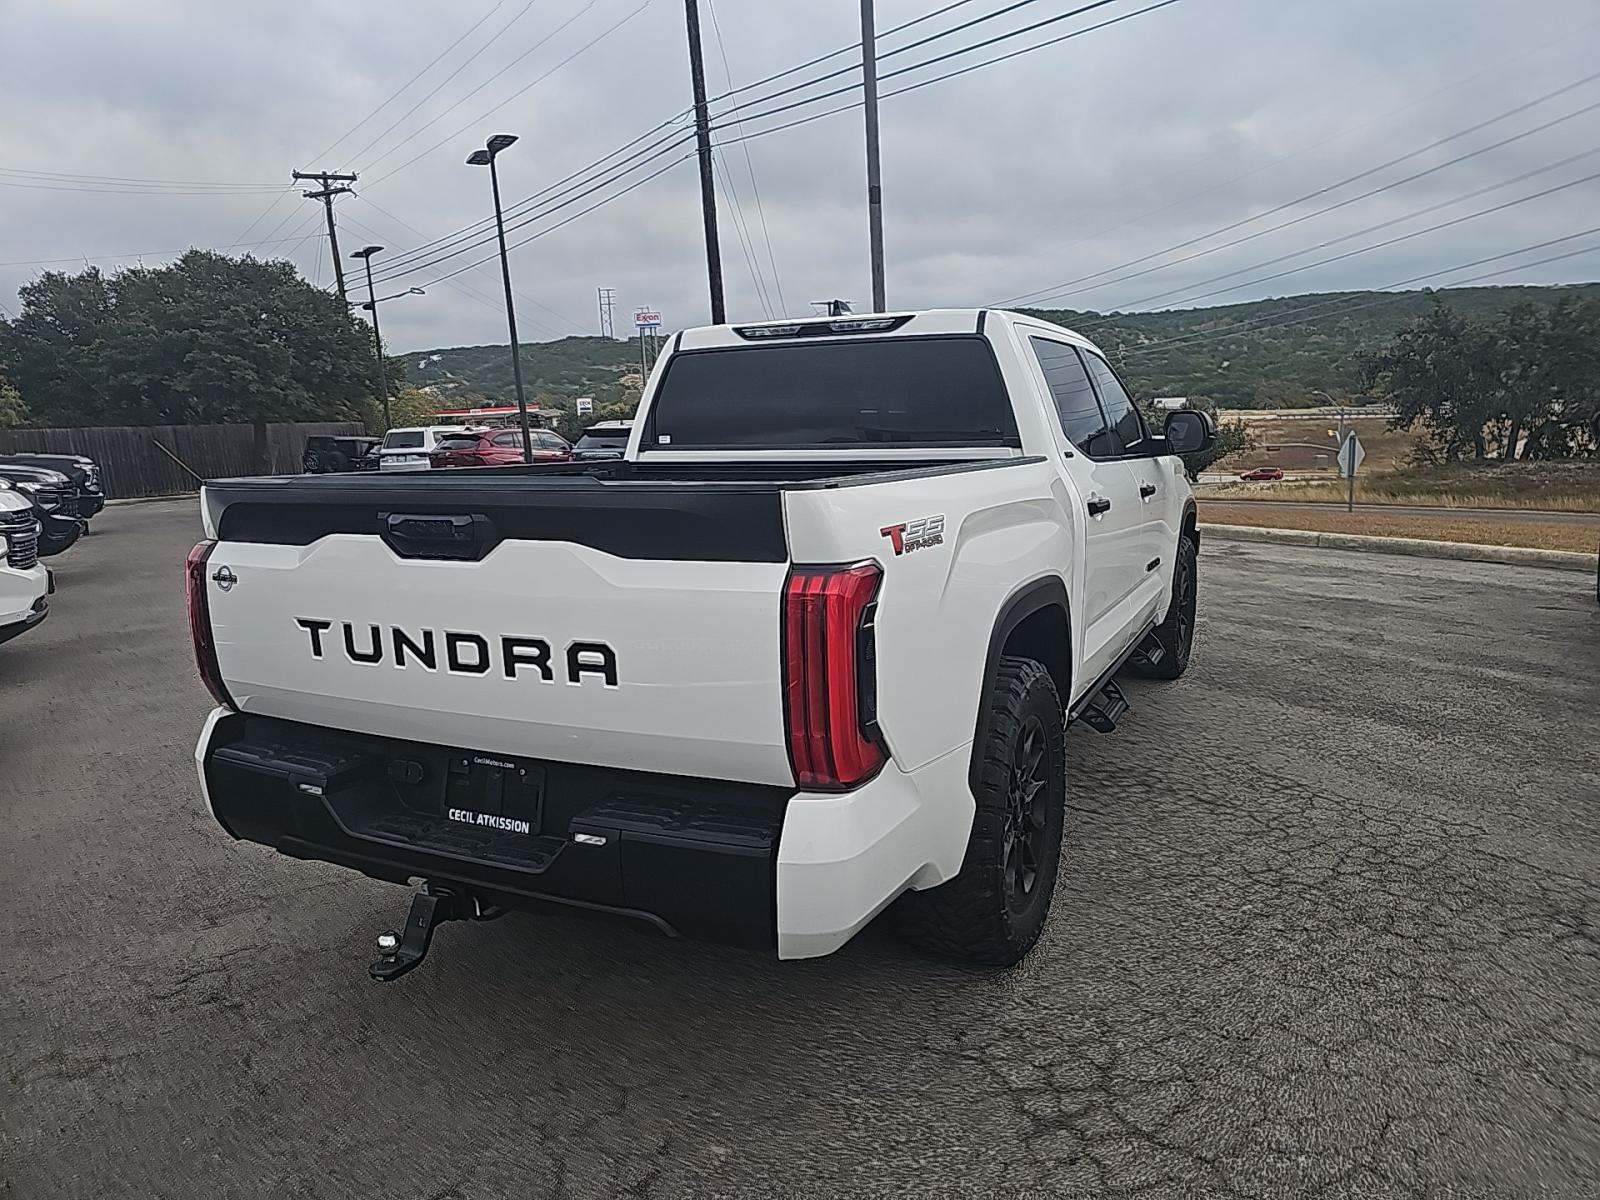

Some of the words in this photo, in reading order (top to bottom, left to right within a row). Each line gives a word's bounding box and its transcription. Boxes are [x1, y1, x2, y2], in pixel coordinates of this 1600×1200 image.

[636, 314, 660, 323] Exxon
[294, 616, 620, 689] TUNDRA
[473, 756, 515, 769] CecilMotors.com
[448, 808, 475, 824] CECIL
[476, 813, 530, 834] ATKISSION
